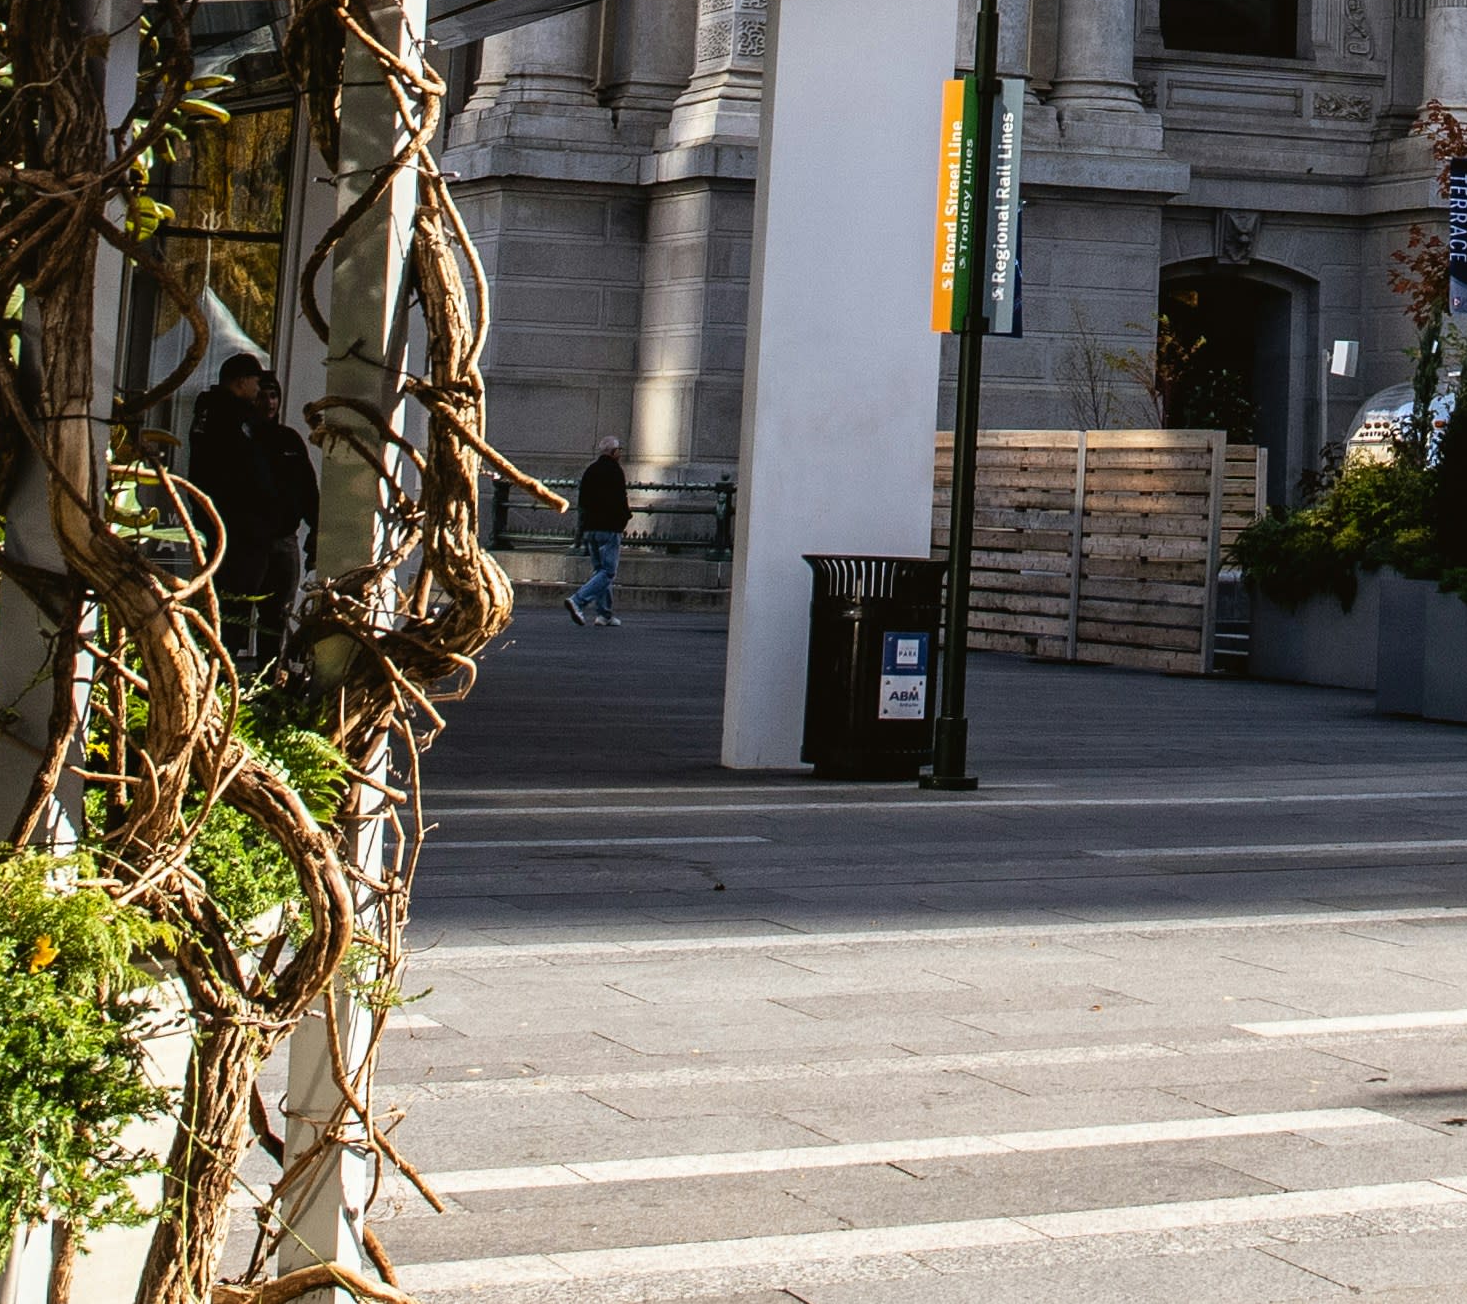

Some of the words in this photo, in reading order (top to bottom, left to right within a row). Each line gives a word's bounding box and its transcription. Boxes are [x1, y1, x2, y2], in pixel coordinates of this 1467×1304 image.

[948, 120, 963, 153] Line
[997, 111, 1014, 159] Lines
[963, 138, 974, 185] Lines
[996, 164, 1011, 200] Rail
[945, 164, 960, 216] Street
[959, 192, 972, 252] Trolley
[992, 203, 1011, 283] Regional
[1449, 173, 1467, 263] TERRACE
[942, 218, 958, 274] Broad
[889, 691, 919, 701] ABM
